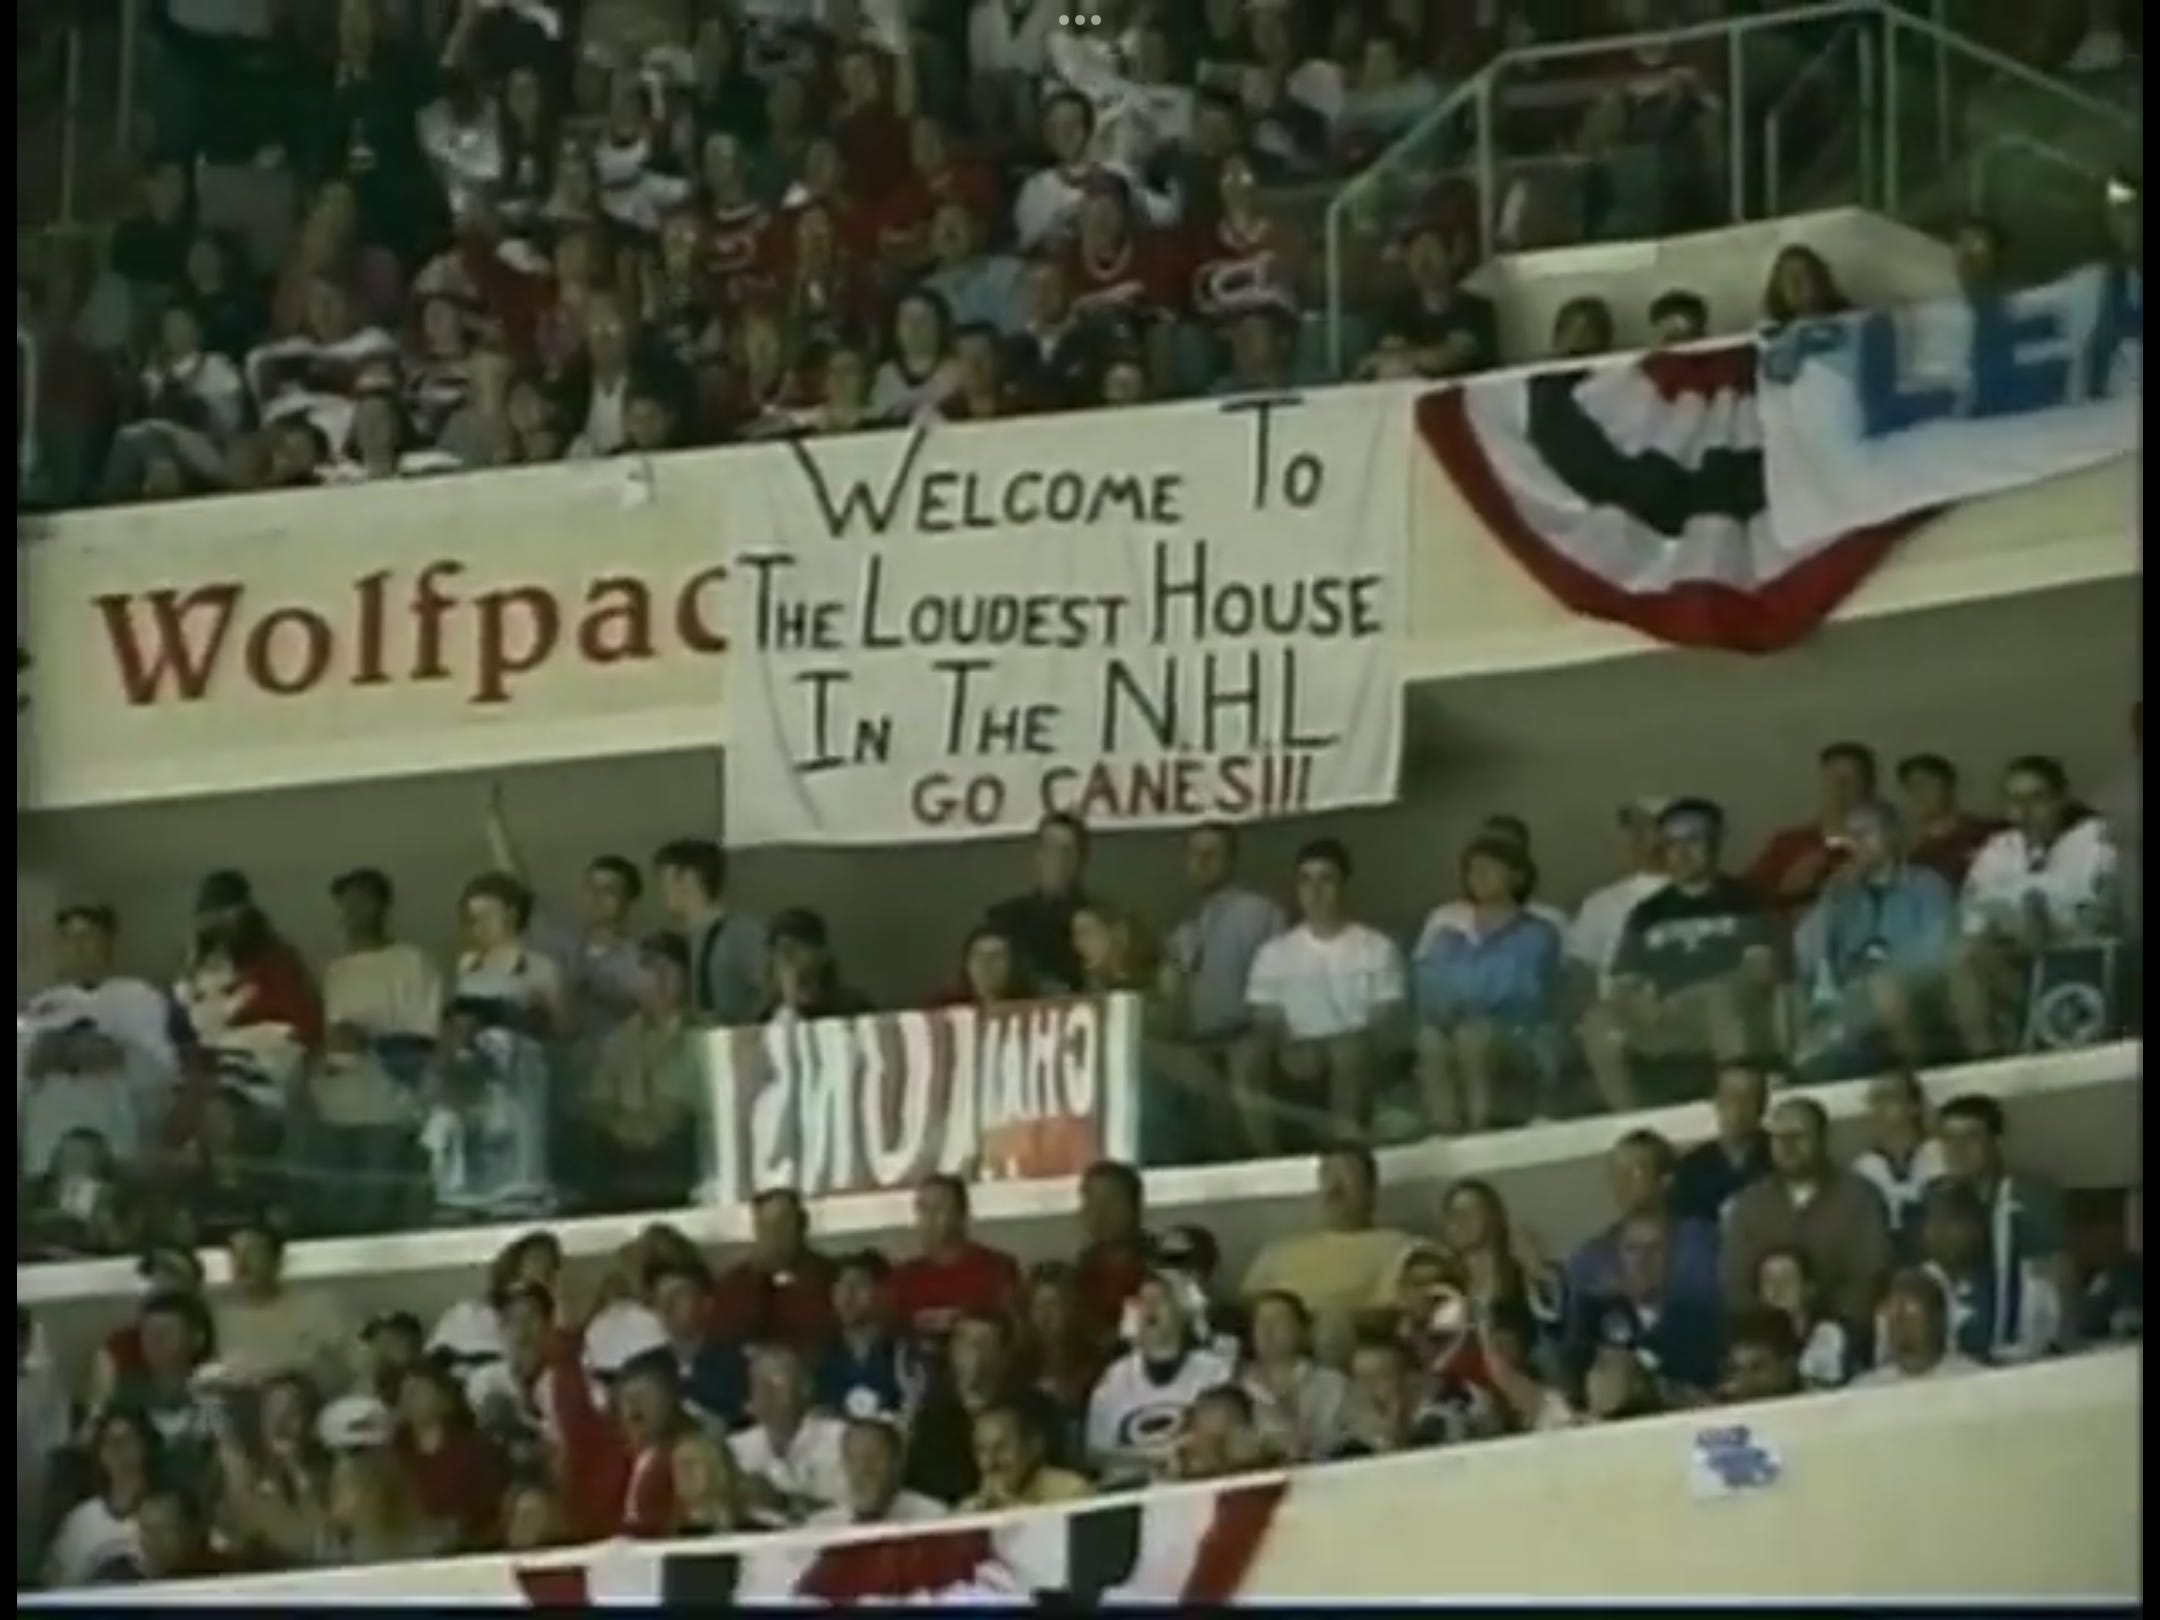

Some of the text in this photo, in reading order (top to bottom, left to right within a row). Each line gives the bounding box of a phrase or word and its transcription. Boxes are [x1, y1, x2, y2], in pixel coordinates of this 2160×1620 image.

[788, 397, 1324, 538] WELCOME TO
[737, 539, 1384, 651] THE LOUDEST HOUSE
[794, 670, 893, 773] IN
[932, 659, 1060, 755] THE
[911, 773, 1006, 826] GO
